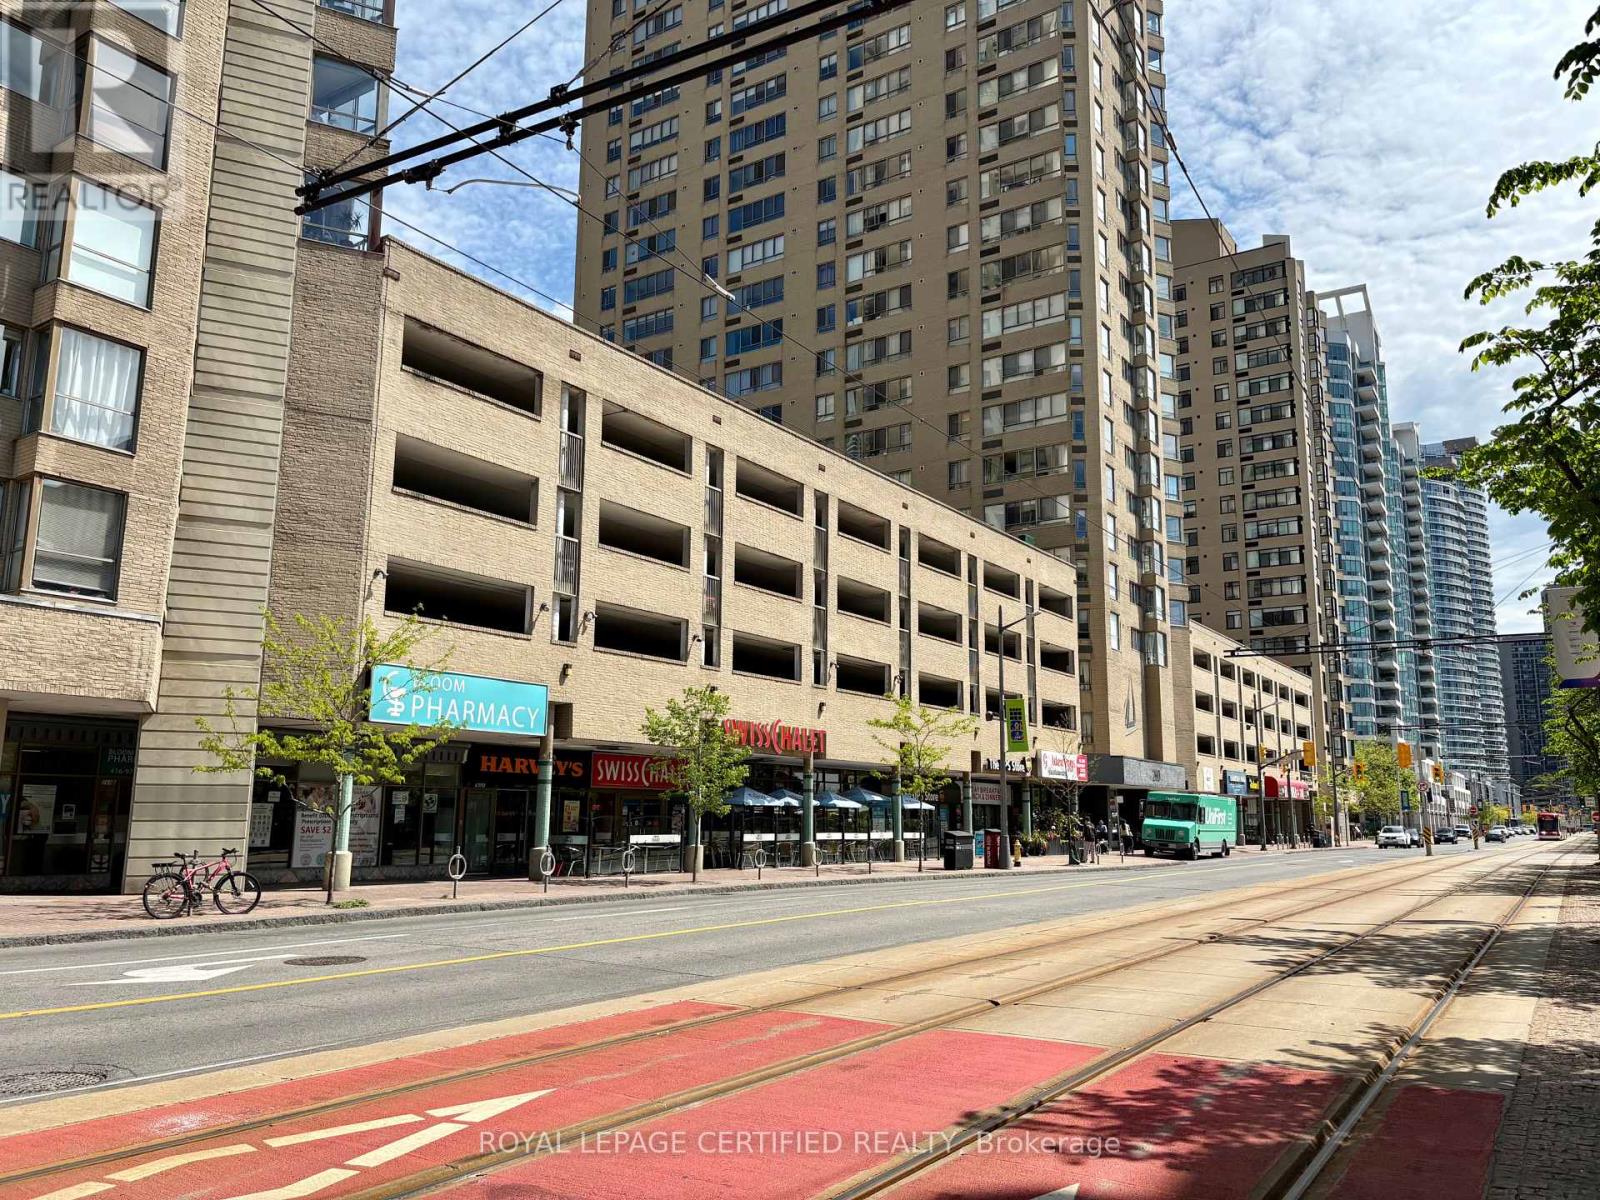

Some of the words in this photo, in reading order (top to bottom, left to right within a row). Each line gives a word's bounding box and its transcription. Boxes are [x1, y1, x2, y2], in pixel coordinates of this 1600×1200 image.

[411, 694, 540, 729] PHARMACY
[480, 755, 584, 777] HARVY'S
[301, 826, 320, 834] SAVE
